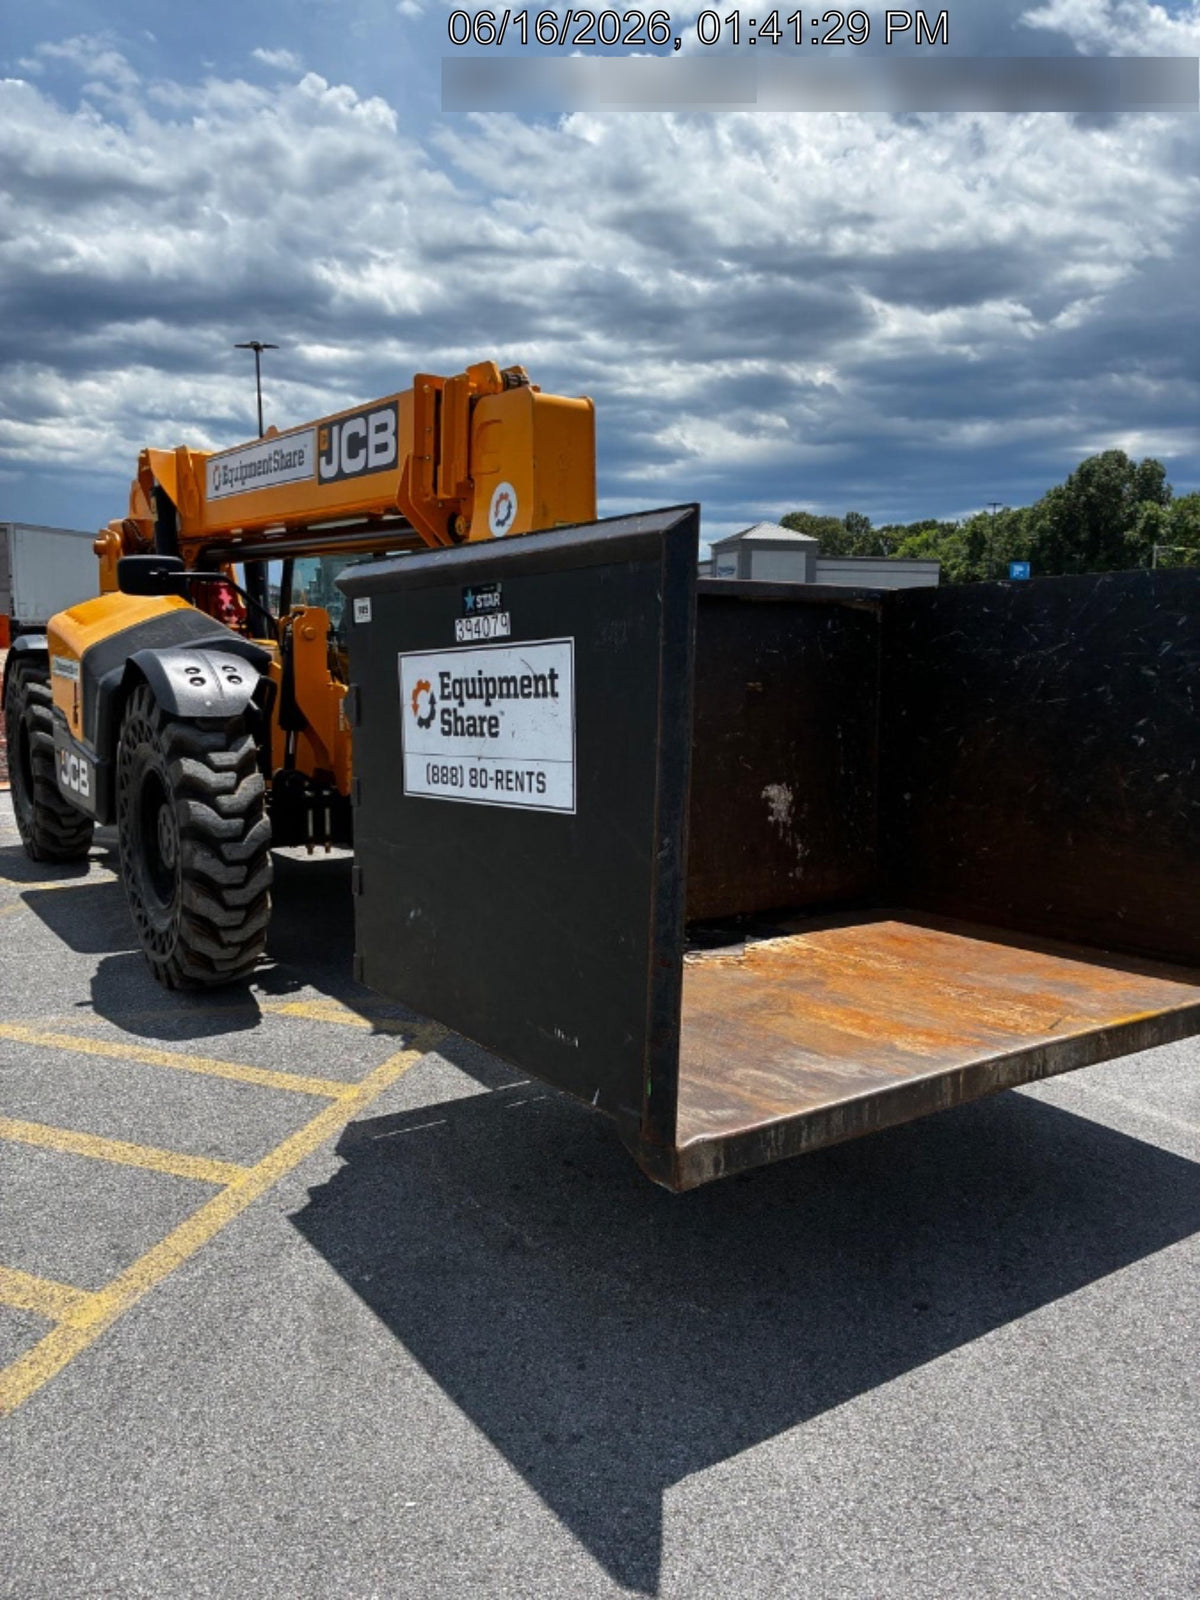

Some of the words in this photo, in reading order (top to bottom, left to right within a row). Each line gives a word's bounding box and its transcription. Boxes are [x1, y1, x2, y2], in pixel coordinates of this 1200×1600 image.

[320, 409, 396, 478] JCB
[222, 449, 304, 488] EquipmentShare
[456, 614, 509, 640] 394079
[439, 668, 559, 706] Equipment
[440, 708, 500, 738] Share
[60, 750, 89, 797] JCB
[426, 763, 464, 788] (888)
[469, 768, 547, 794] 80-RENTS
